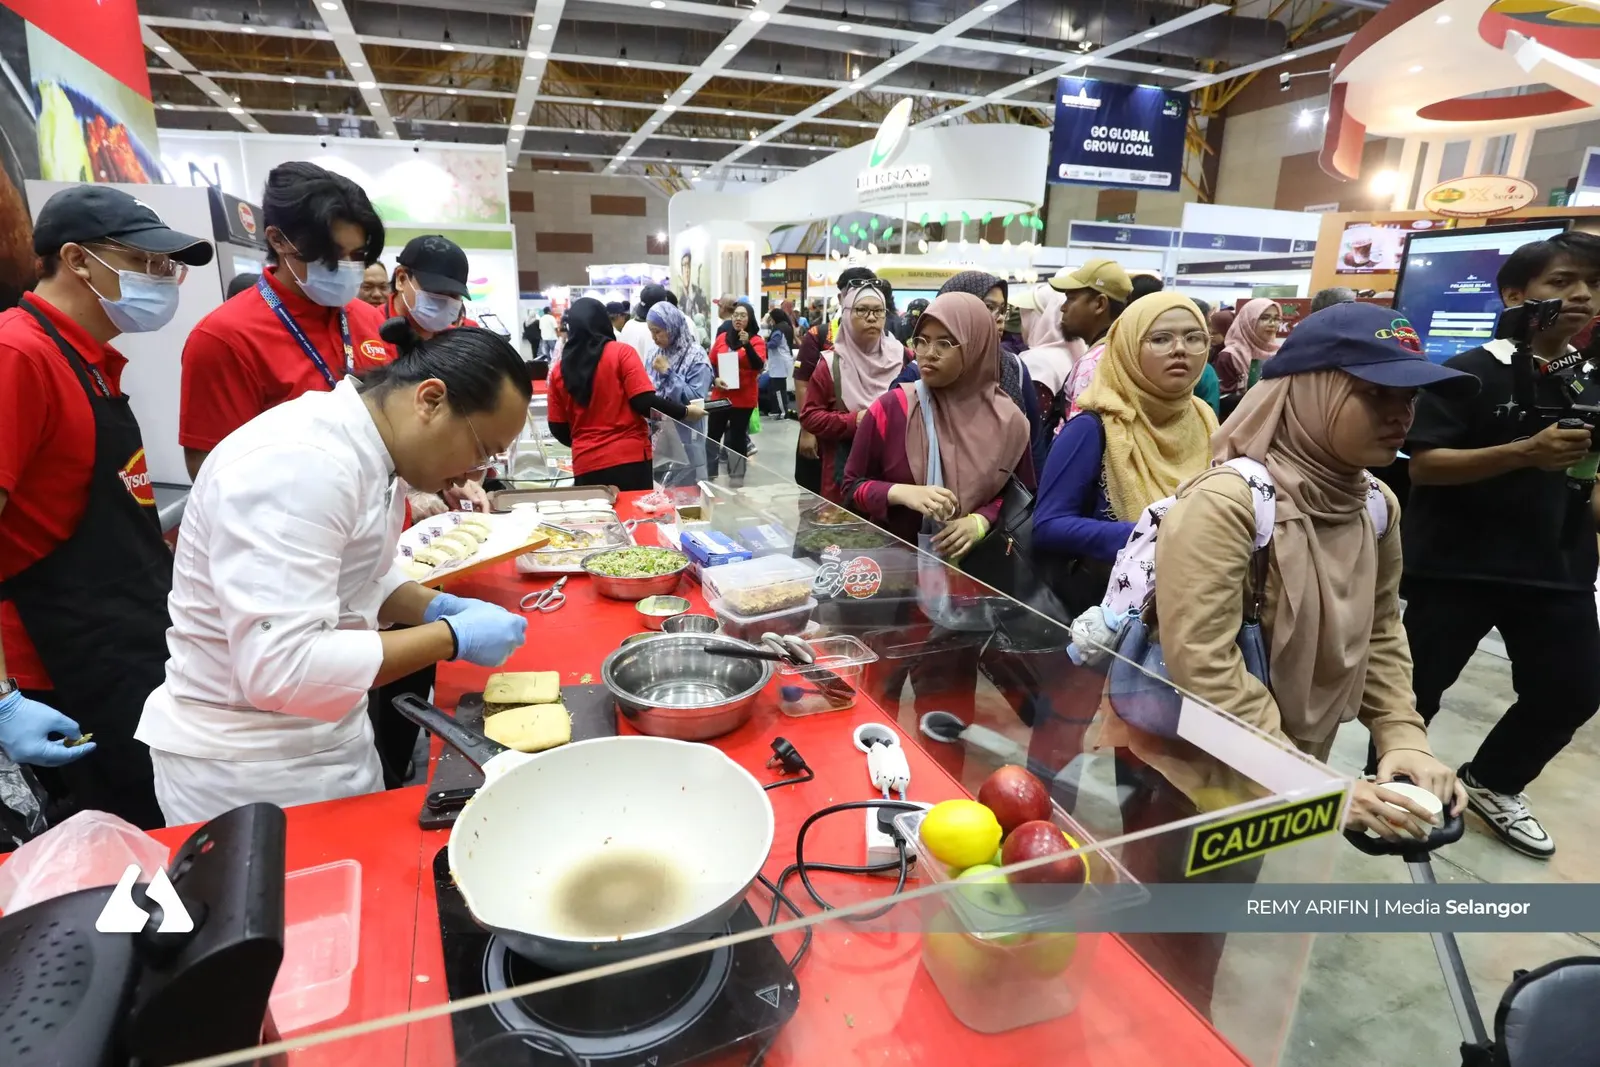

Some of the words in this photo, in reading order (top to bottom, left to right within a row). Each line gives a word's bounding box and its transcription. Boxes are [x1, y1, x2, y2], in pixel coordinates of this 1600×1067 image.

[1091, 126, 1108, 138] GO
[1109, 128, 1150, 143] GLOBAL
[1083, 139, 1119, 154] GROW
[1120, 143, 1154, 157] LOCAL
[1547, 352, 1583, 373] RONIN
[813, 562, 881, 598] Gyoza
[1202, 801, 1334, 862] CAUTION
